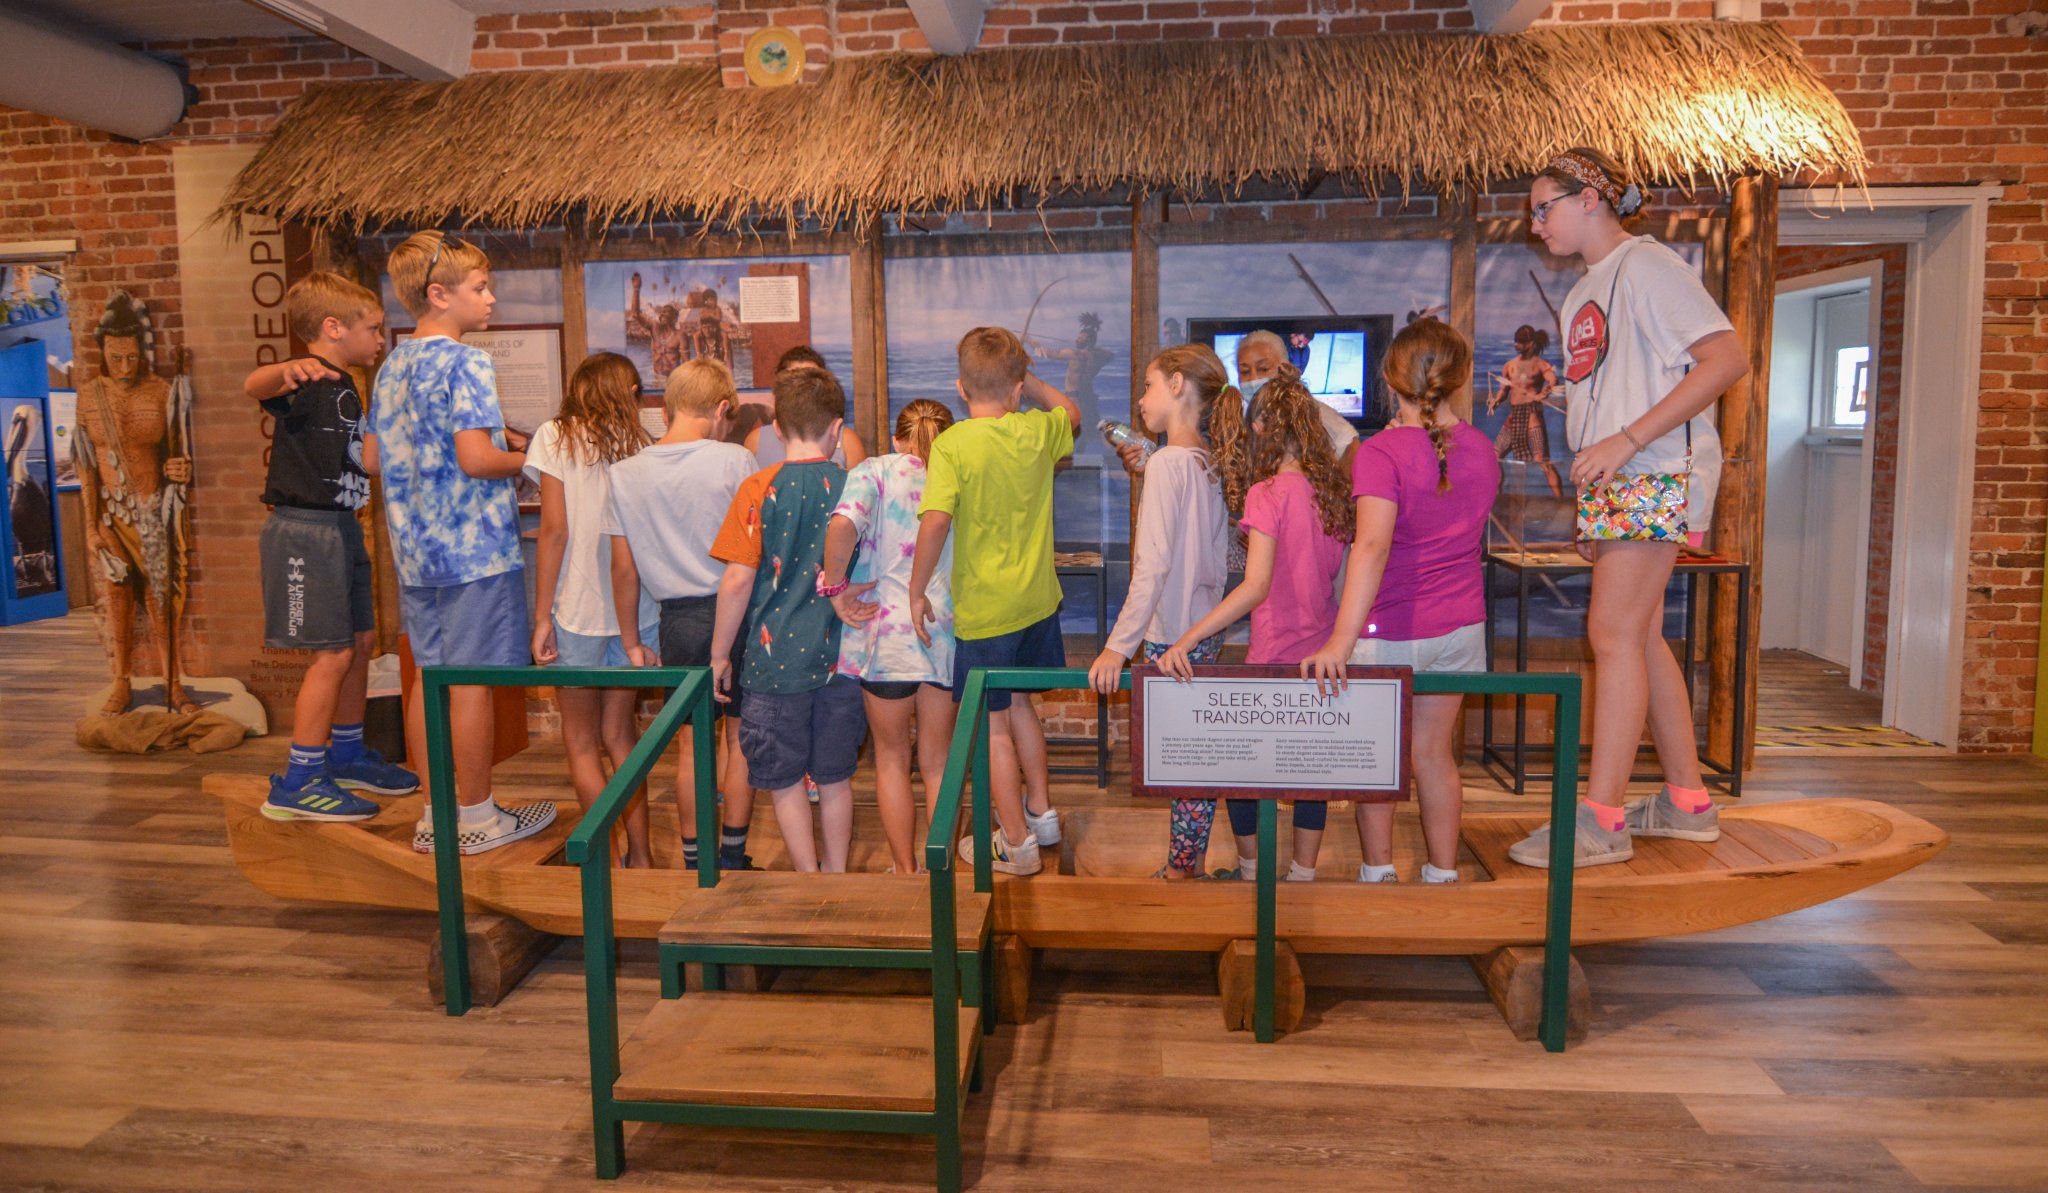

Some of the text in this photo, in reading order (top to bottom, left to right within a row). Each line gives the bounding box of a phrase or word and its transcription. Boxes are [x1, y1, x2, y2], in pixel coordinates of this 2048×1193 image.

[249, 226, 288, 368] PEOPL
[288, 584, 296, 636] ARMOUR
[296, 584, 304, 625] UNDER
[274, 674, 304, 683] Weav
[1208, 692, 1334, 709] SLEEK, SILENT
[1192, 709, 1351, 726] TRANSPORTATION
